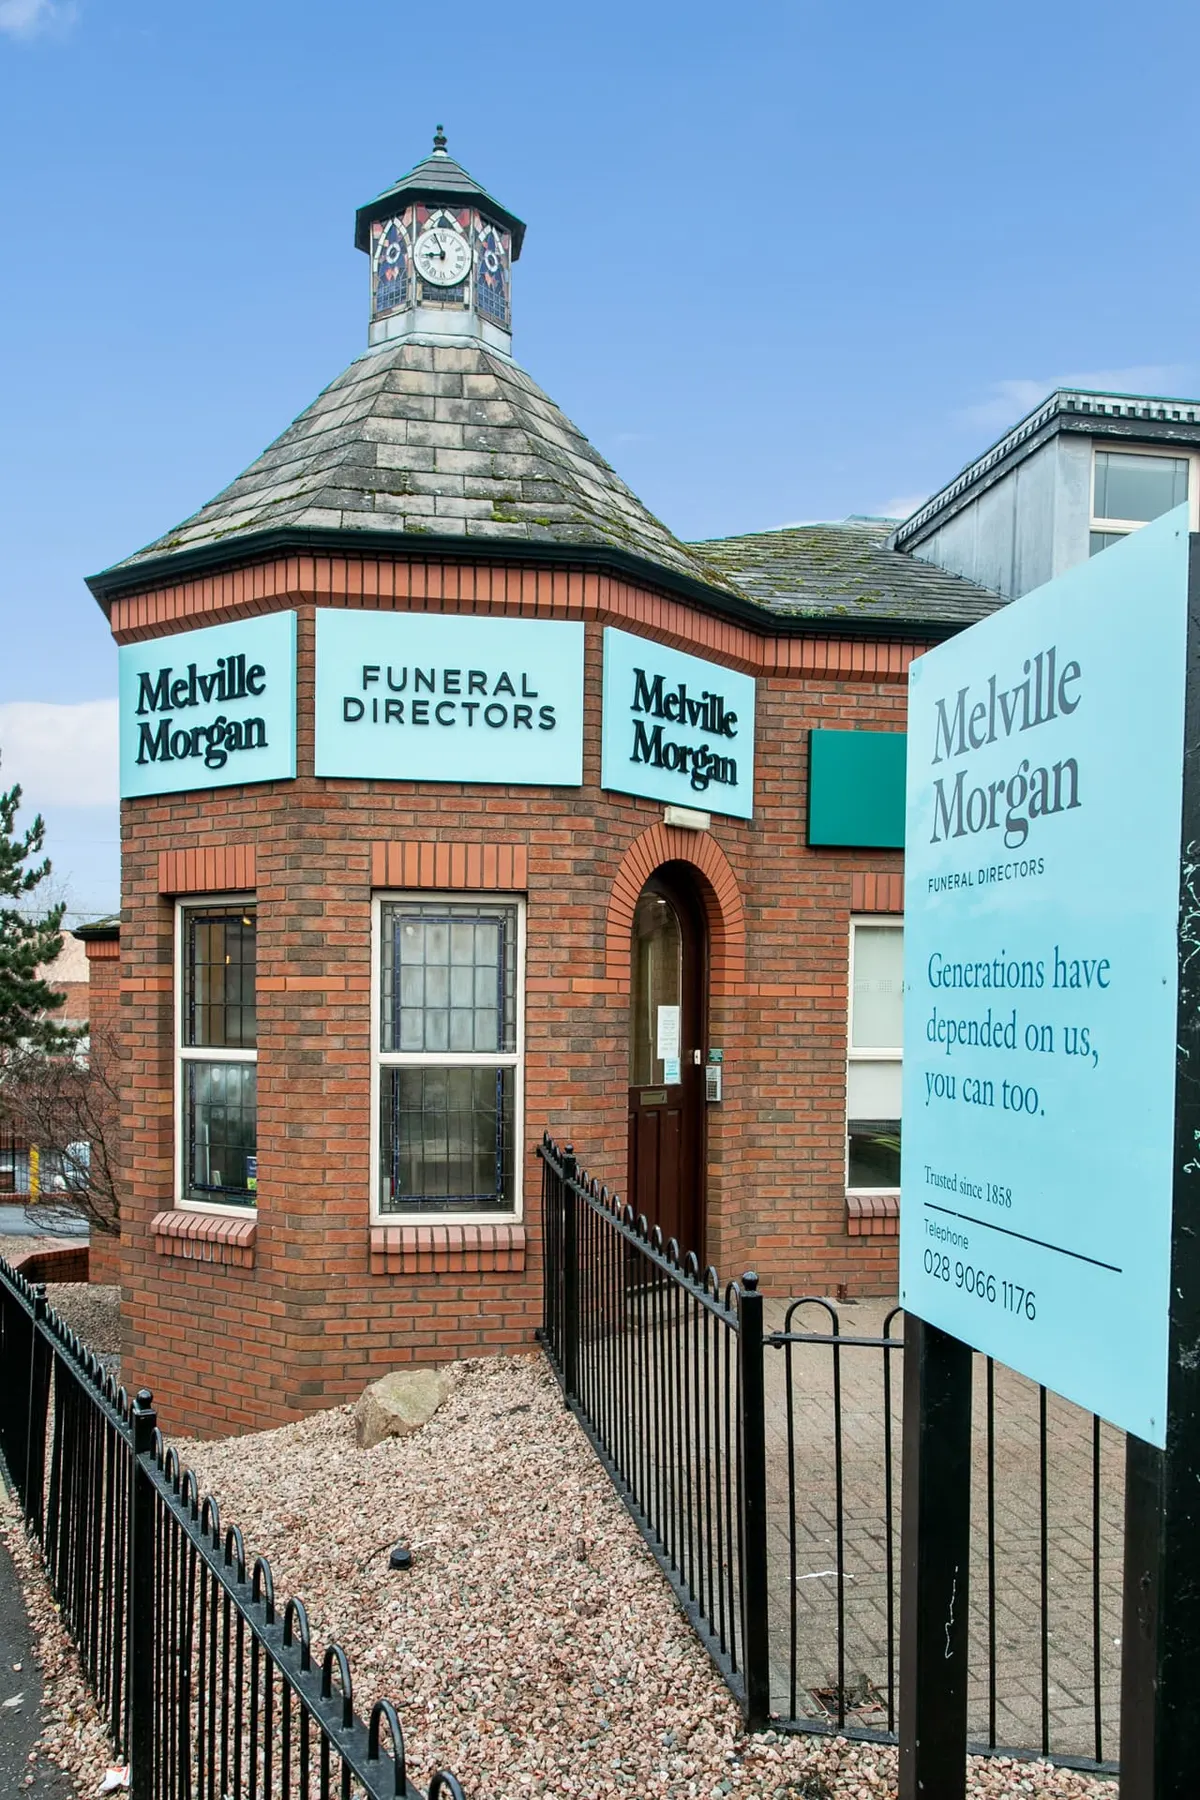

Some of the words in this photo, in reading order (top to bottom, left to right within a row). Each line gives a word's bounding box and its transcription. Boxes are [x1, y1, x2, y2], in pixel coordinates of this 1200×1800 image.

[135, 653, 266, 714] Melville
[362, 665, 538, 698] FUNERAL
[630, 668, 738, 738] Melville
[931, 645, 1082, 765] Melville
[135, 714, 268, 769] Morgan
[343, 698, 557, 730] DIRECTORS
[629, 719, 738, 791] Morgan
[930, 757, 1082, 849] Morgan
[928, 872, 974, 893] FUNERAL
[978, 858, 1045, 885] DIRECTORS
[928, 949, 1045, 989] Generations
[1052, 945, 1111, 988] have
[927, 1007, 1017, 1055] depended
[1025, 1024, 1055, 1053] on
[1064, 1027, 1099, 1068] us,
[925, 1071, 957, 1106] you
[962, 1078, 995, 1107] can
[1002, 1080, 1045, 1116] too.
[924, 1165, 958, 1193] Trusted
[959, 1177, 983, 1199] since
[986, 1183, 1013, 1208] 1858
[924, 1219, 969, 1250] Telephone
[924, 1249, 951, 1283] 028
[955, 1262, 997, 1303] 9066
[1001, 1281, 1037, 1321] 1176
